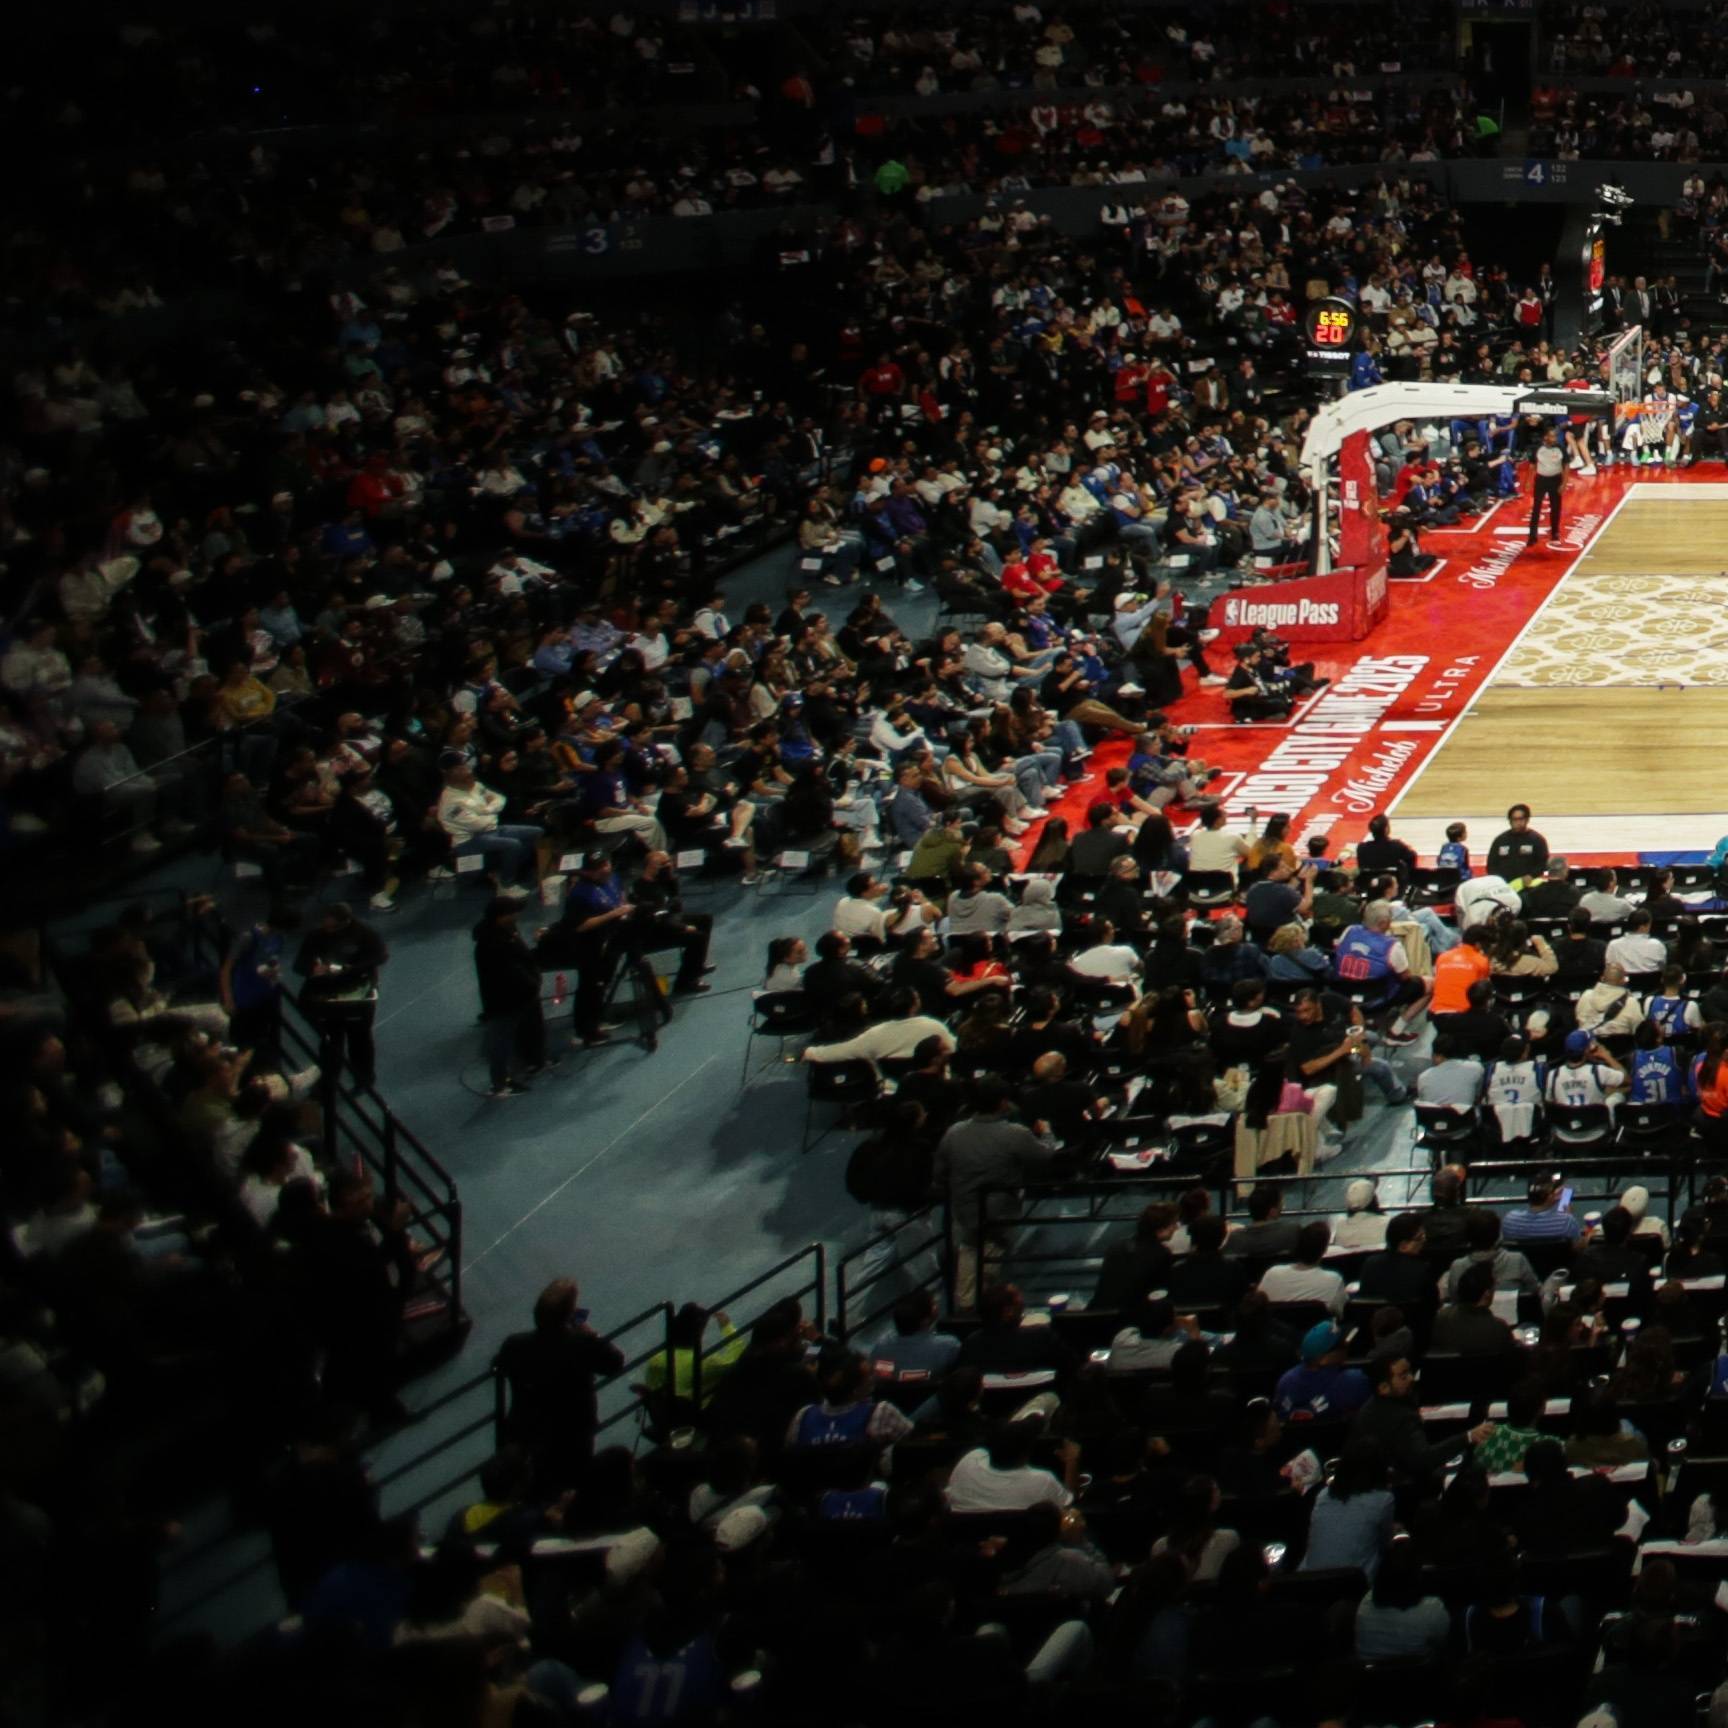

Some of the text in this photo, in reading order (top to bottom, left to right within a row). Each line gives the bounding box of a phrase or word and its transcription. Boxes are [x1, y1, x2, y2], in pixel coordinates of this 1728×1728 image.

[1527, 163, 1544, 183] 4
[585, 228, 608, 254] 3
[1316, 325, 1343, 343] 20
[1240, 598, 1339, 629] League Pass
[1332, 654, 1430, 693] 2025
[1295, 692, 1400, 734] GAME
[1331, 655, 1480, 813] Michelob ULTRA
[1259, 734, 1363, 770] CITY
[1643, 1078, 1668, 1103] 31
[633, 1663, 687, 1716] 77
